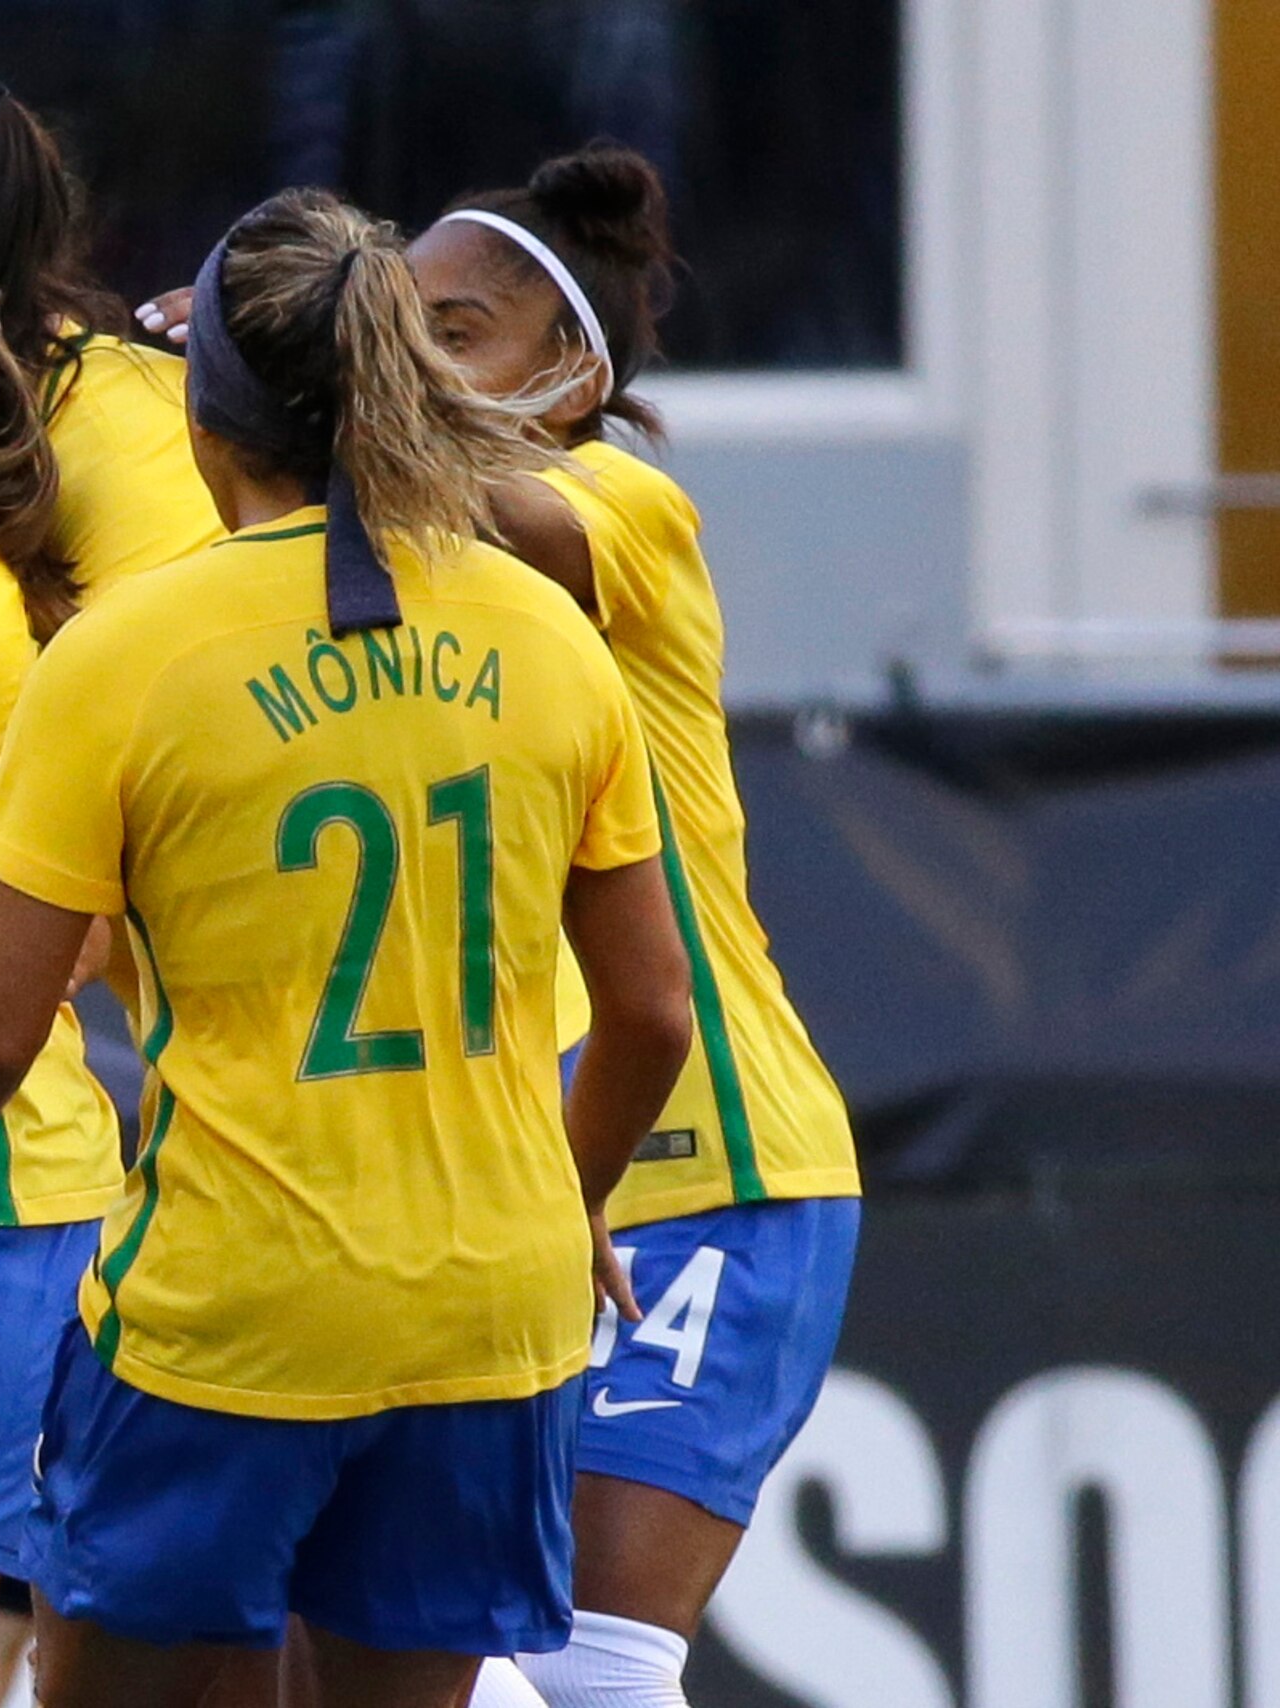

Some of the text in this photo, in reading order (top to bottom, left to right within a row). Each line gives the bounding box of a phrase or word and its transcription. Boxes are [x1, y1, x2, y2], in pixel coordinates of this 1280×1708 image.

[245, 625, 501, 743] MÔNICA
[275, 763, 496, 1083] 21
[706, 1363, 1280, 1708] SO
